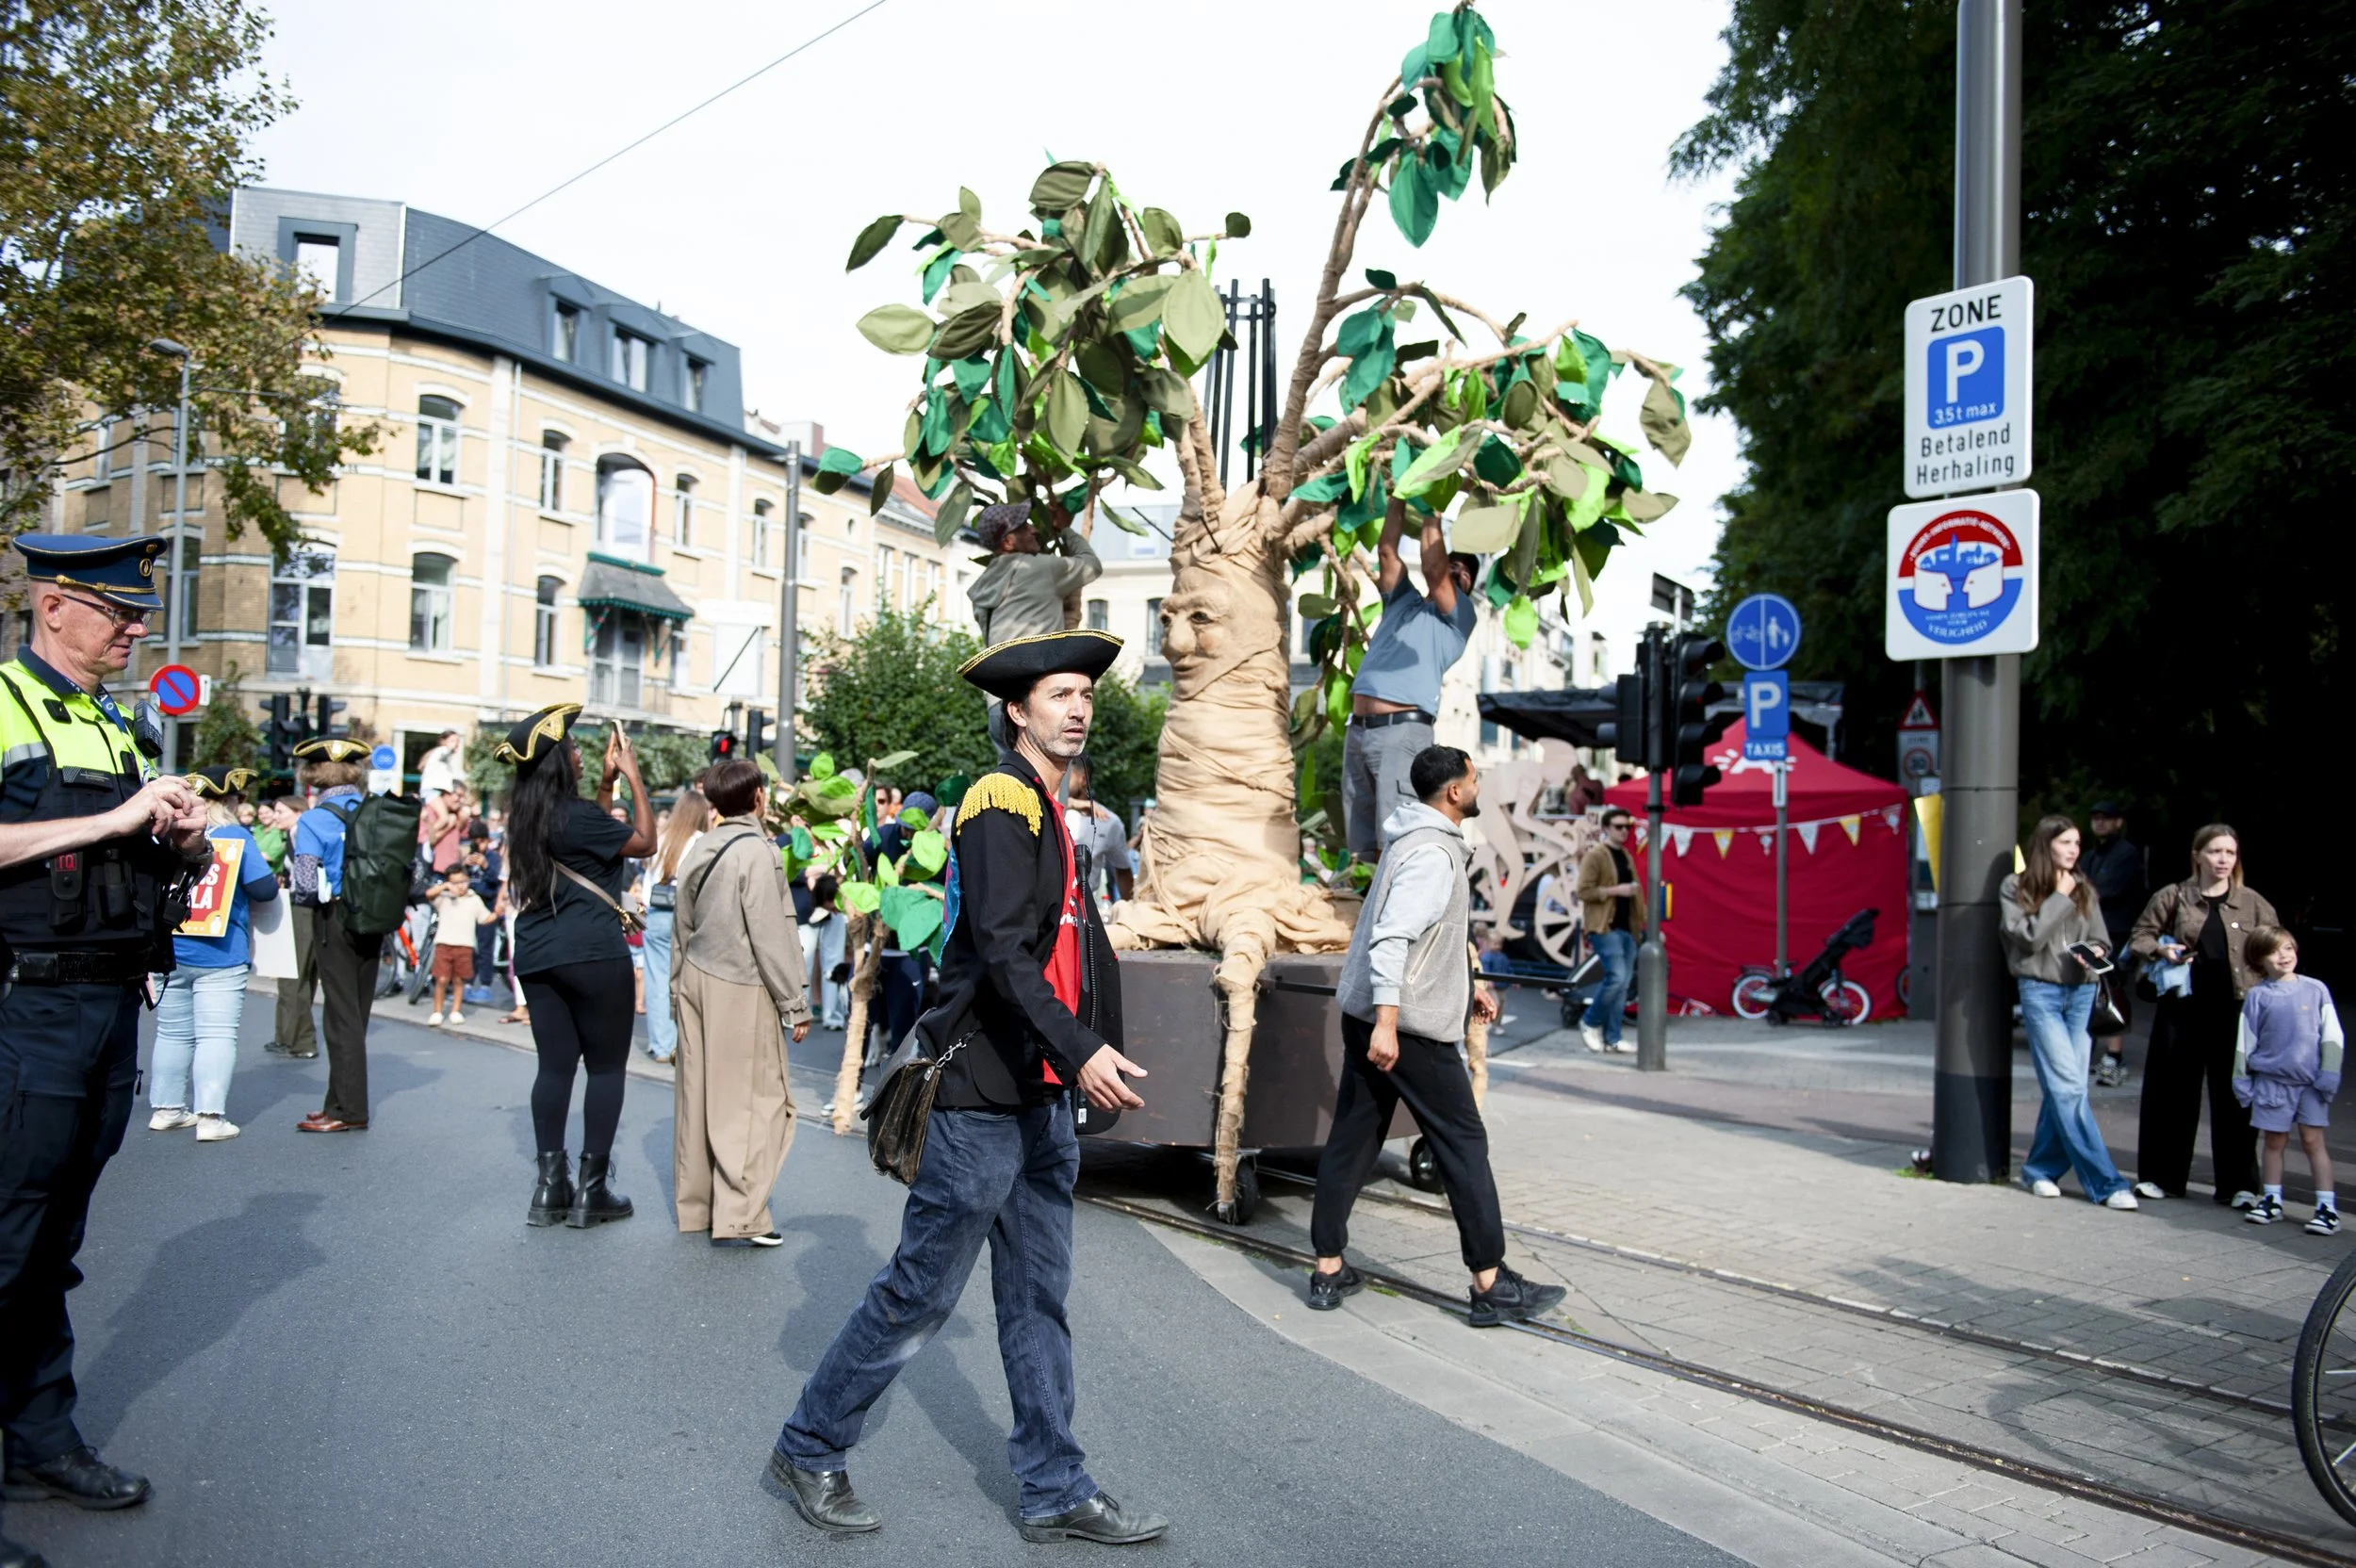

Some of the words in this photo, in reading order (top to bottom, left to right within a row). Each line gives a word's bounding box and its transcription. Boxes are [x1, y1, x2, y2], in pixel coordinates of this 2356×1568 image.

[1930, 295, 2002, 333] ZONE
[1946, 339, 1985, 403] P
[1966, 401, 1996, 419] max
[1922, 422, 2010, 458] Betalend
[1917, 454, 2014, 485] Herhaling
[1750, 680, 1781, 728] P
[1745, 743, 1784, 756] TAXIS
